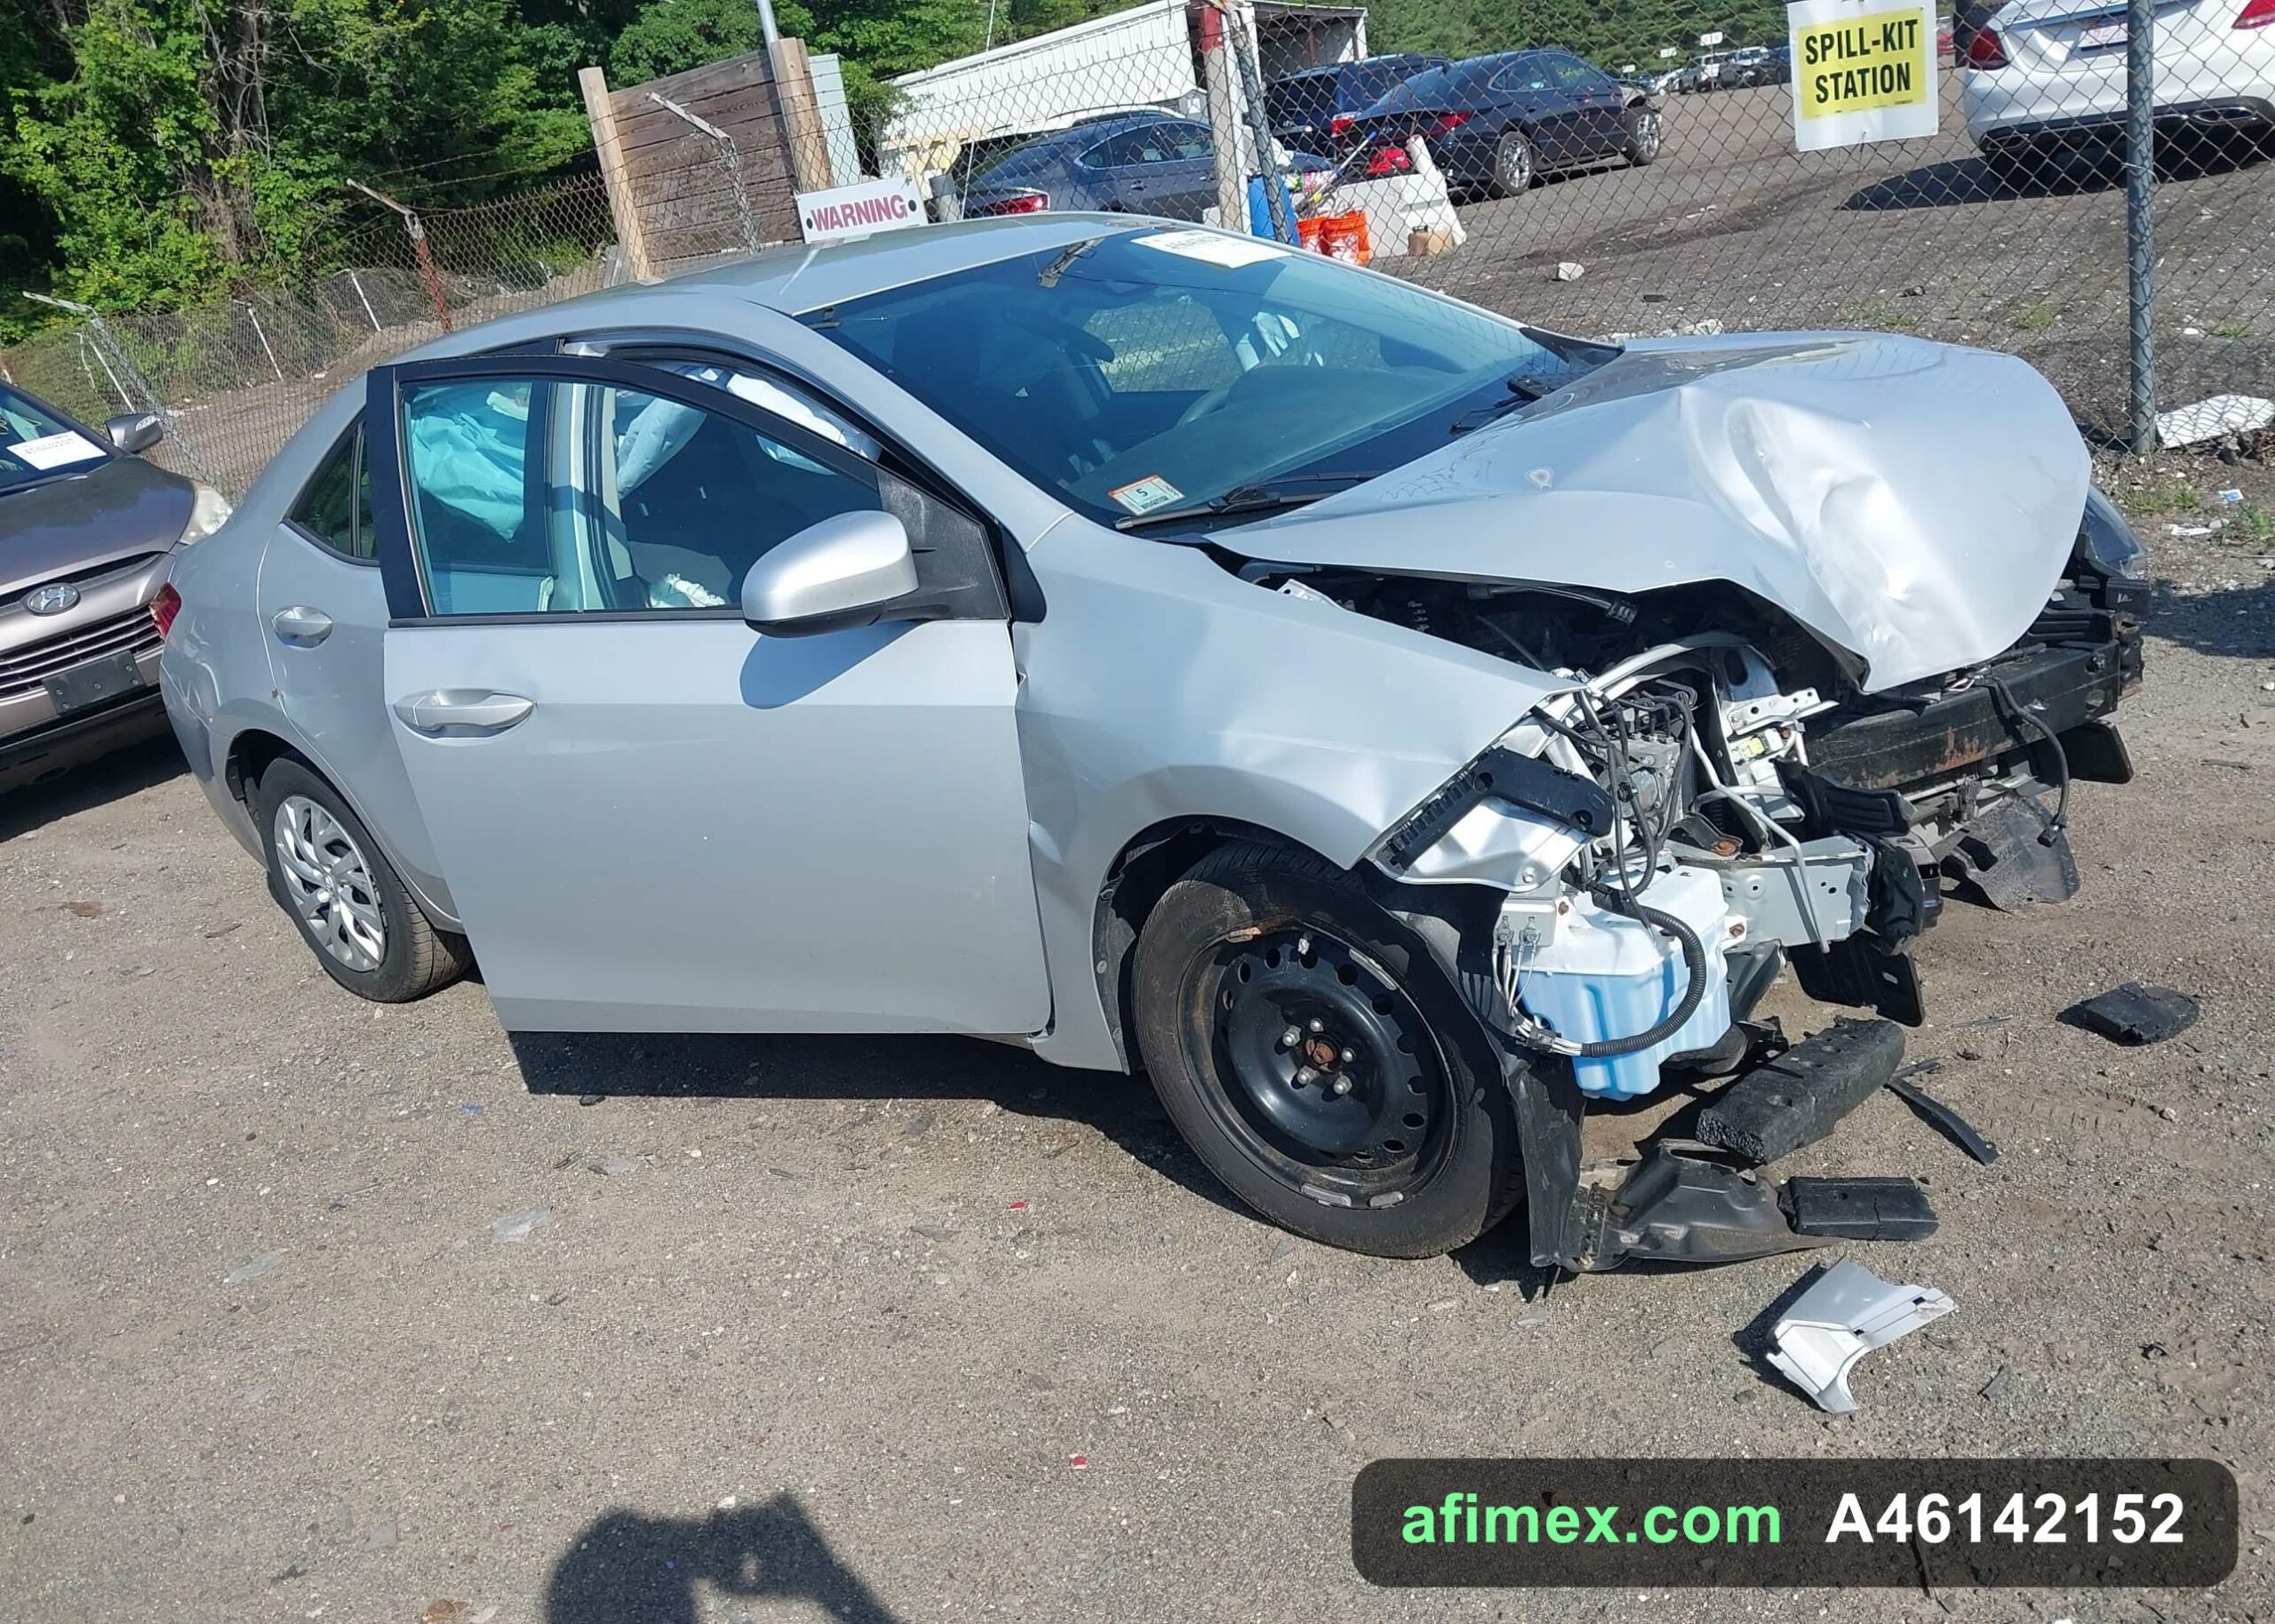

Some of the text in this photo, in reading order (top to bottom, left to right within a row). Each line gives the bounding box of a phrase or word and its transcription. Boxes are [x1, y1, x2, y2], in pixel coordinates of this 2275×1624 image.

[1805, 19, 1919, 66] SPILL-KIT
[1816, 62, 1912, 104] STATION
[810, 194, 908, 232] WARNING
[1136, 488, 1148, 498] 5
